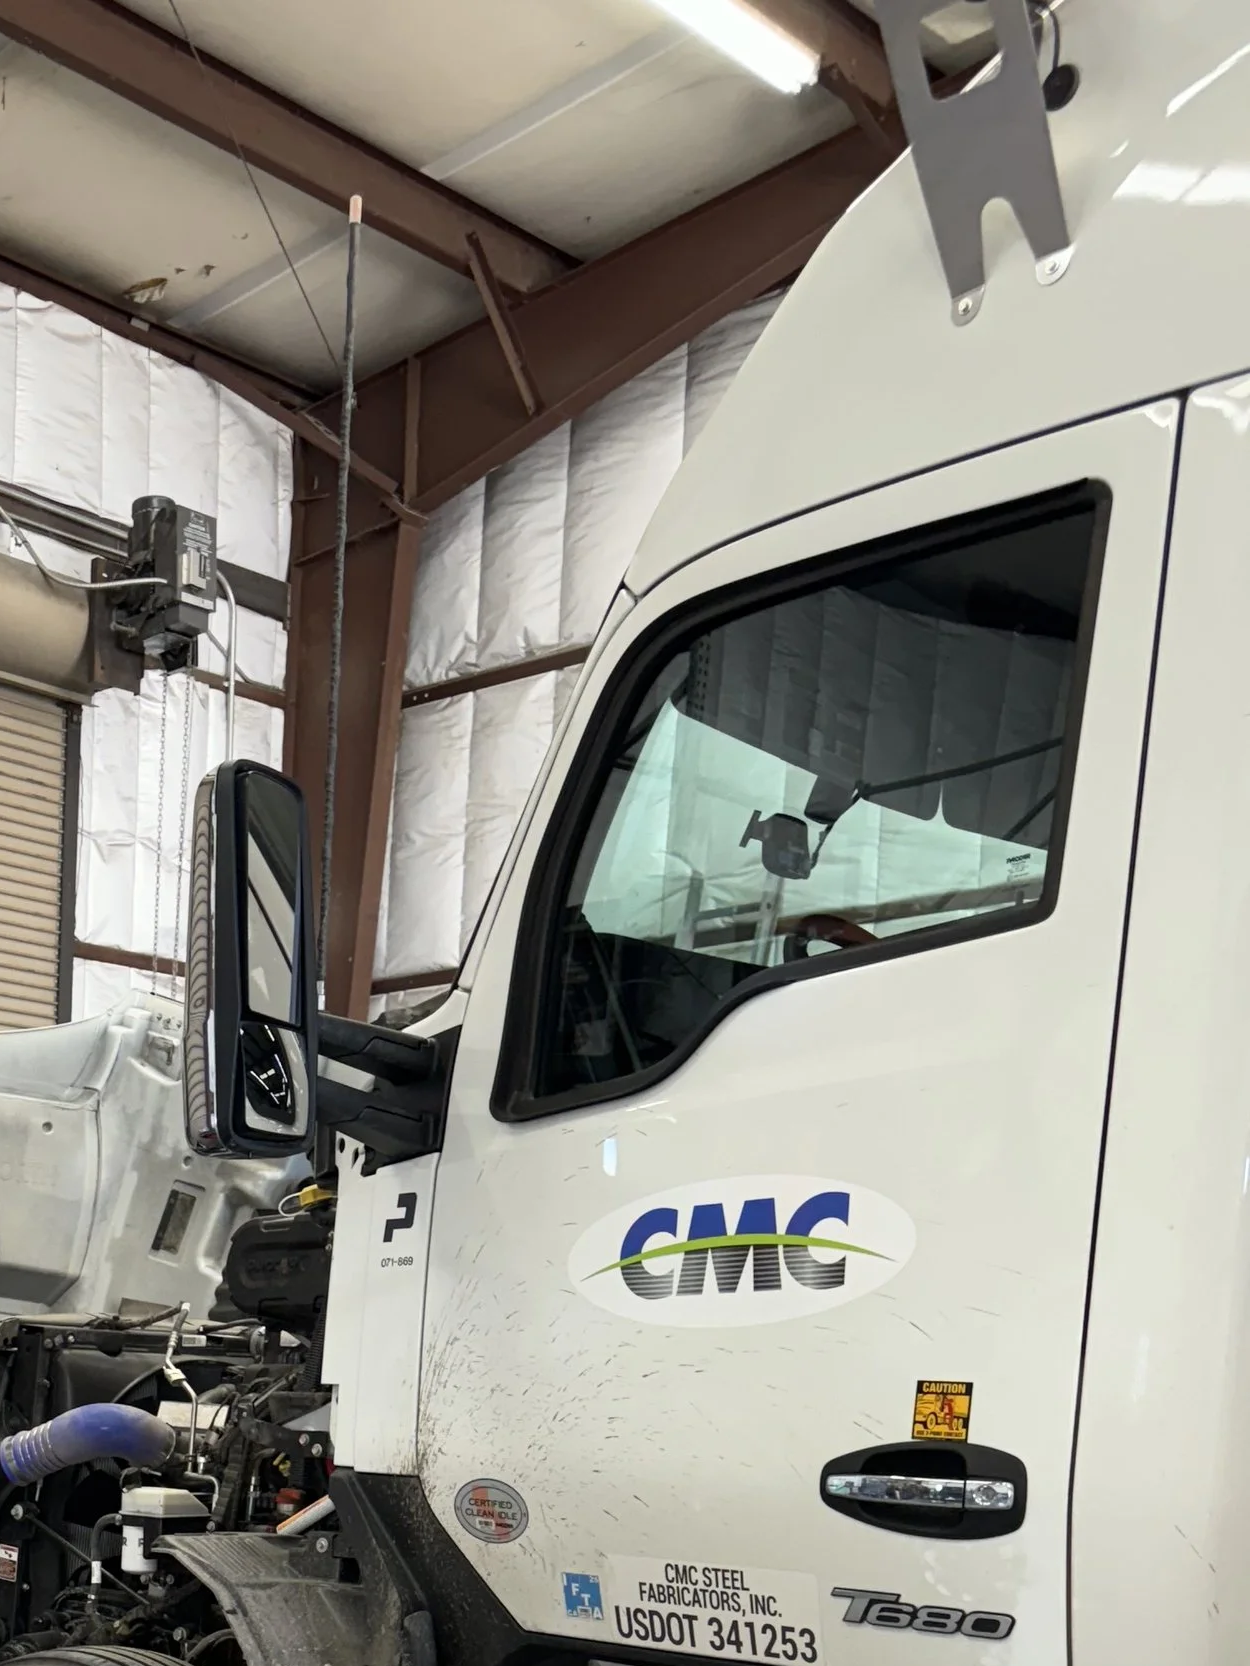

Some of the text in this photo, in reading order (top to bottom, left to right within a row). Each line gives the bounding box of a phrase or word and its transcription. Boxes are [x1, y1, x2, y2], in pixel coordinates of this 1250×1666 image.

[620, 1191, 850, 1300] CMC
[381, 1256, 414, 1268] 071-869
[922, 1382, 967, 1394] CAUTION
[465, 1508, 518, 1521] CLEAN IDLE
[468, 1498, 513, 1510] CERTIFIED
[664, 1563, 750, 1591] CMC STEEL
[639, 1582, 783, 1617] FABRICATORS, INC.
[830, 1587, 1016, 1639] T680
[614, 1605, 818, 1663] USDOT 341253
